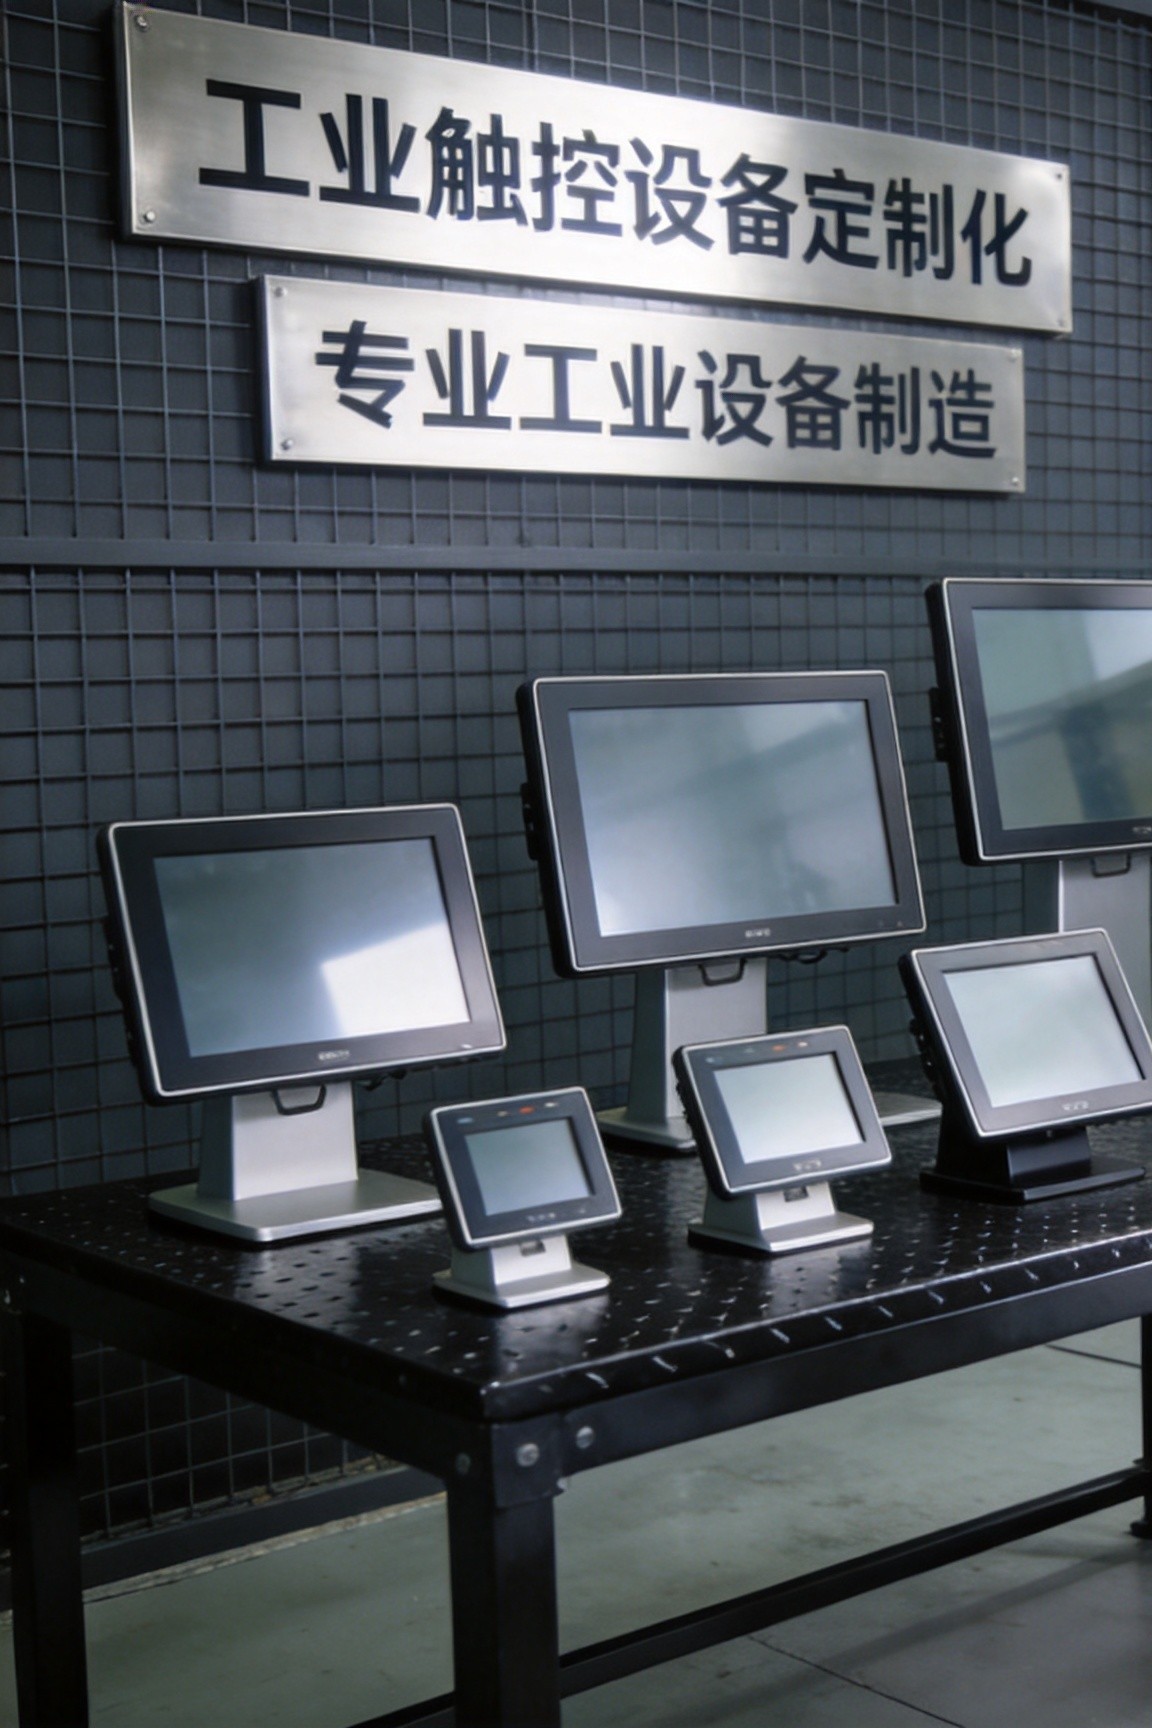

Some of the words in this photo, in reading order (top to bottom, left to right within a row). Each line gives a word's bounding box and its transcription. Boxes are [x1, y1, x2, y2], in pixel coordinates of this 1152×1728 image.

[199, 78, 1033, 289] 工业触控设备定制化
[315, 320, 997, 459] 专业工业设备制造
